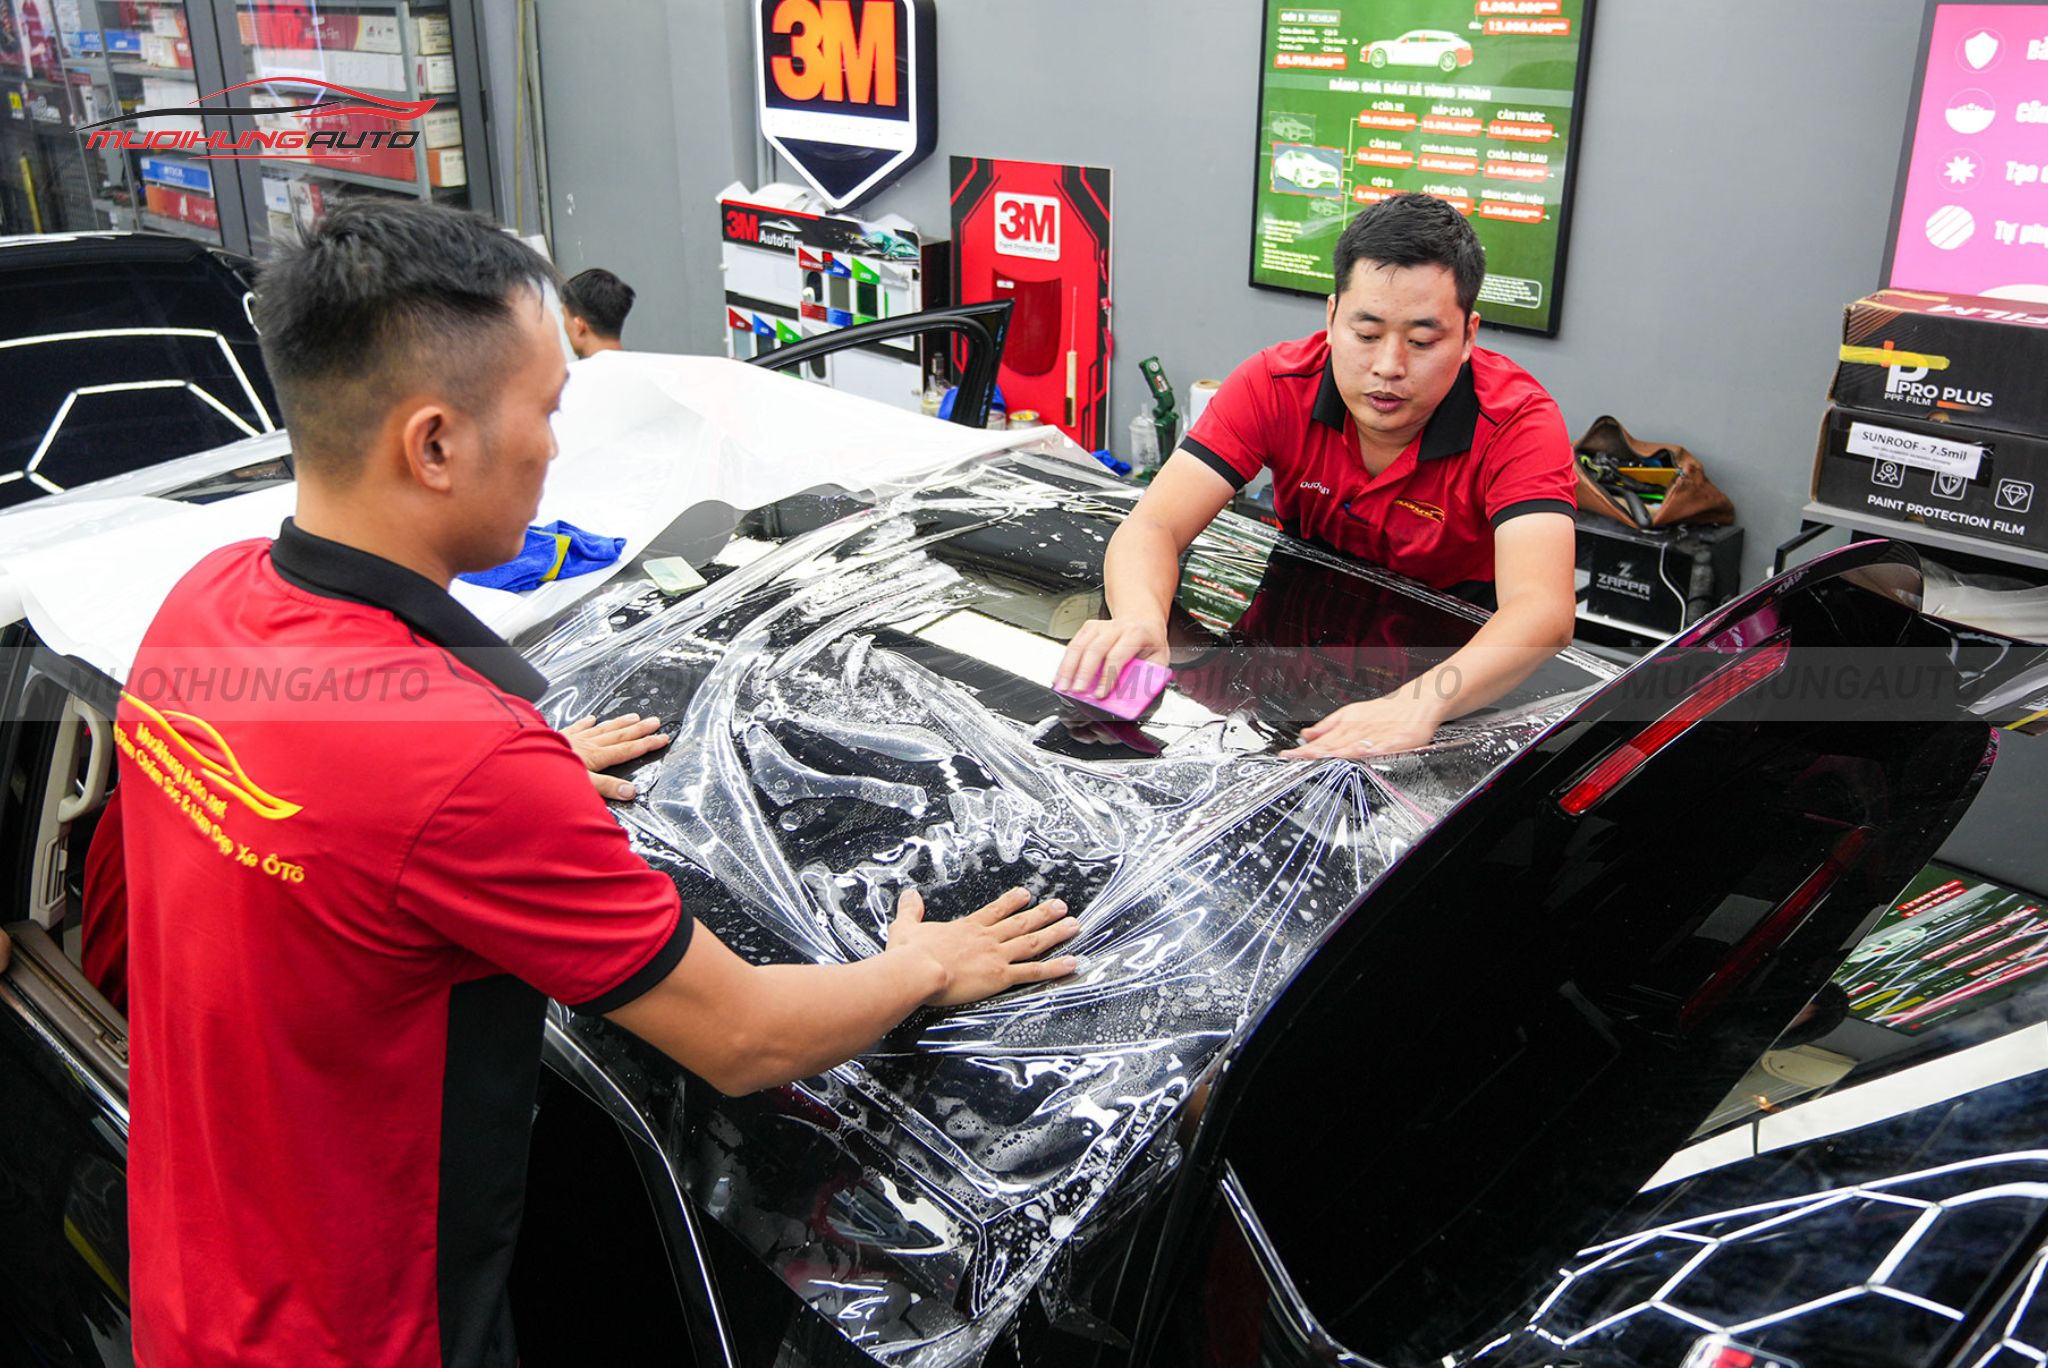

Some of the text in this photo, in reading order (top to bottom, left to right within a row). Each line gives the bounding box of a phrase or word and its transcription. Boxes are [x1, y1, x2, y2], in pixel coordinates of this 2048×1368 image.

[771, 0, 897, 107] 3M
[726, 210, 758, 242] 3M
[1000, 200, 1055, 245] 3M
[1884, 392, 1932, 406] PPF FILM
[1897, 381, 1994, 408] PRO PLUS
[1862, 431, 1920, 453] SUNROOF
[1930, 444, 1968, 462] 7.5mil
[1867, 493, 2026, 537] PAINT PROTECTION FILM
[1597, 572, 1651, 595] ZAPPA
[235, 842, 259, 868] Xe
